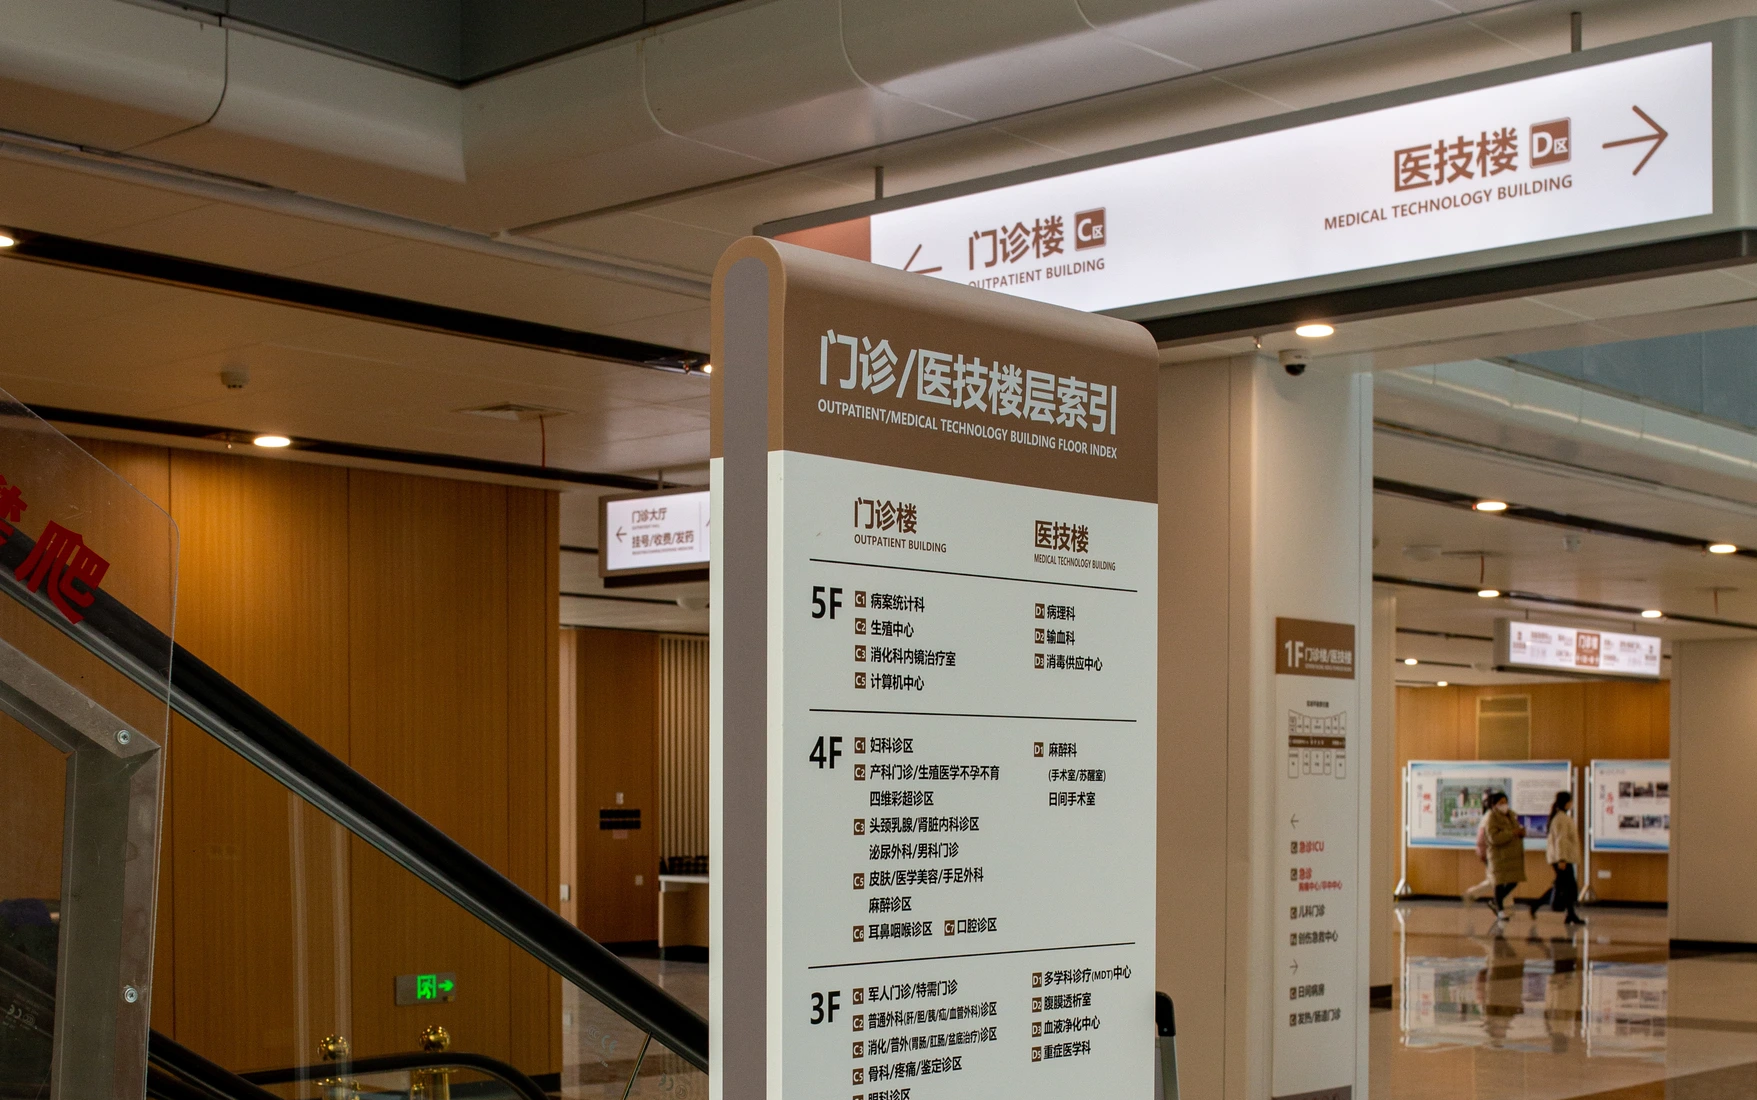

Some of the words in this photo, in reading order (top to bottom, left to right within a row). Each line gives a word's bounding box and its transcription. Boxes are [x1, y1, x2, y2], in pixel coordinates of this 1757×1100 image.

[1394, 127, 1518, 193] 医技楼
[1324, 207, 1388, 231] MEDICAL
[1392, 189, 1492, 219] TECHNOLOGY
[1497, 175, 1573, 200] BUILDING
[968, 215, 1065, 271] 门诊楼
[1046, 258, 1105, 279] BUILDING
[820, 328, 1117, 435] 门诊/医技楼层索引
[818, 398, 938, 431] OUTPATIENT/MEDICAL
[940, 418, 1008, 441] TECHNOLOGY
[1010, 430, 1056, 450] BUILDING
[1058, 438, 1088, 455] FLOOR
[1090, 443, 1118, 459] INDEX
[854, 497, 917, 534] 门诊楼
[854, 534, 906, 550] OUTPATIENT
[908, 540, 947, 553] BUILDING
[1034, 520, 1089, 553] 医技楼
[1034, 553, 1057, 565] MEDICAL
[1058, 556, 1091, 569] TECHNOLOGY
[1091, 559, 1116, 571] BUILDING
[811, 586, 843, 620] 5F
[855, 592, 866, 607] C1
[871, 593, 925, 613] 病案统计科
[1035, 604, 1044, 618] D1
[1047, 604, 1075, 621] 病理科
[855, 619, 866, 634] C2
[871, 619, 914, 638] 生殖中心
[1035, 629, 1044, 643] D2
[1047, 629, 1075, 646] 输血科
[855, 646, 866, 661] C3
[871, 646, 956, 667] 消化科内镜治疗室
[1035, 654, 1044, 668] D3
[1046, 653, 1103, 672] 消毒供应中心
[1284, 639, 1304, 668] 1F
[855, 673, 866, 688] C5
[871, 673, 925, 691] 计算机中心
[809, 736, 843, 769] 4F
[855, 738, 866, 753] C1
[870, 737, 913, 753] 妇科诊区
[1034, 743, 1044, 756] D1
[1048, 742, 1077, 758] 麻醉科
[854, 765, 865, 780] C2
[870, 764, 1000, 781] 产科门诊/生殖医学不孕不育
[870, 791, 934, 806] 四维彩超诊区
[1049, 791, 1096, 807] 日间手术室
[854, 820, 865, 834] C3
[869, 816, 980, 834] 头颈乳腺/肾脏内科诊区
[869, 842, 959, 860] 泌尿外科/男科门诊
[853, 874, 865, 889] C5
[869, 866, 984, 887] 皮肤/医学美容/手足外科
[868, 896, 912, 914] 麻醉诊区
[853, 926, 865, 941] C6
[868, 921, 933, 940] 耳鼻咽喉诊区
[944, 921, 955, 935] C7
[957, 917, 997, 934] 口腔诊区
[1032, 974, 1042, 987] D1
[1044, 965, 1132, 987] 多学科诊疗(MDT)中心
[853, 989, 864, 1004] C1
[868, 979, 958, 1002] 军人门诊/特需门诊
[1032, 998, 1042, 1011] D2
[1043, 992, 1092, 1011] 腹膜透析室
[810, 990, 841, 1025] 3F
[853, 1015, 864, 1031] C2
[1032, 1022, 1042, 1036] D3
[1043, 1015, 1101, 1036] 血液净化中心
[853, 1042, 864, 1057] C3
[1031, 1047, 1042, 1061] D5
[1043, 1040, 1091, 1060] 重症医学科
[853, 1069, 864, 1084] C5
[868, 1056, 963, 1082] 骨科/疼痛/鉴定诊区
